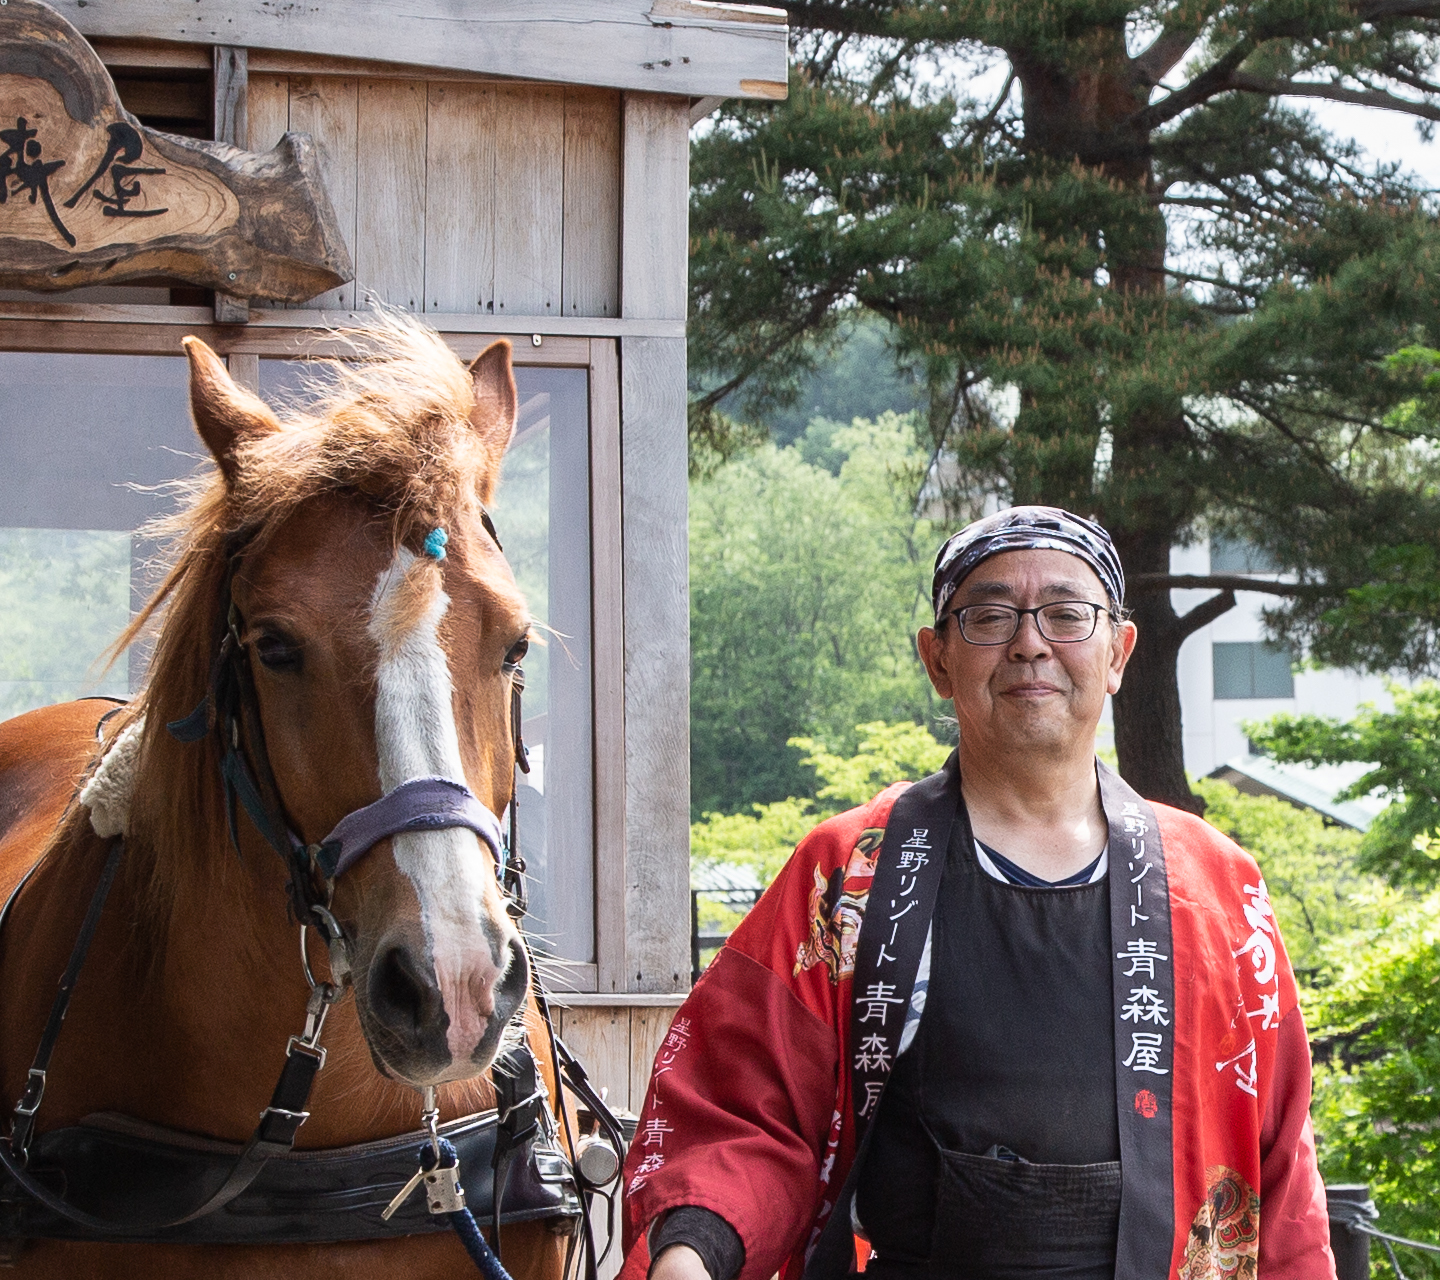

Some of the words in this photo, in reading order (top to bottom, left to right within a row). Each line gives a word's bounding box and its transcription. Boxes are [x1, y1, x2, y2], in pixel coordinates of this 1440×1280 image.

[876, 828, 933, 968] 星野リゾート
[1120, 801, 1154, 927] 星野リゾート
[653, 1017, 691, 1110] 星野リゾート
[1116, 937, 1171, 1075] 青森屋
[626, 1117, 675, 1198] 青森屋
